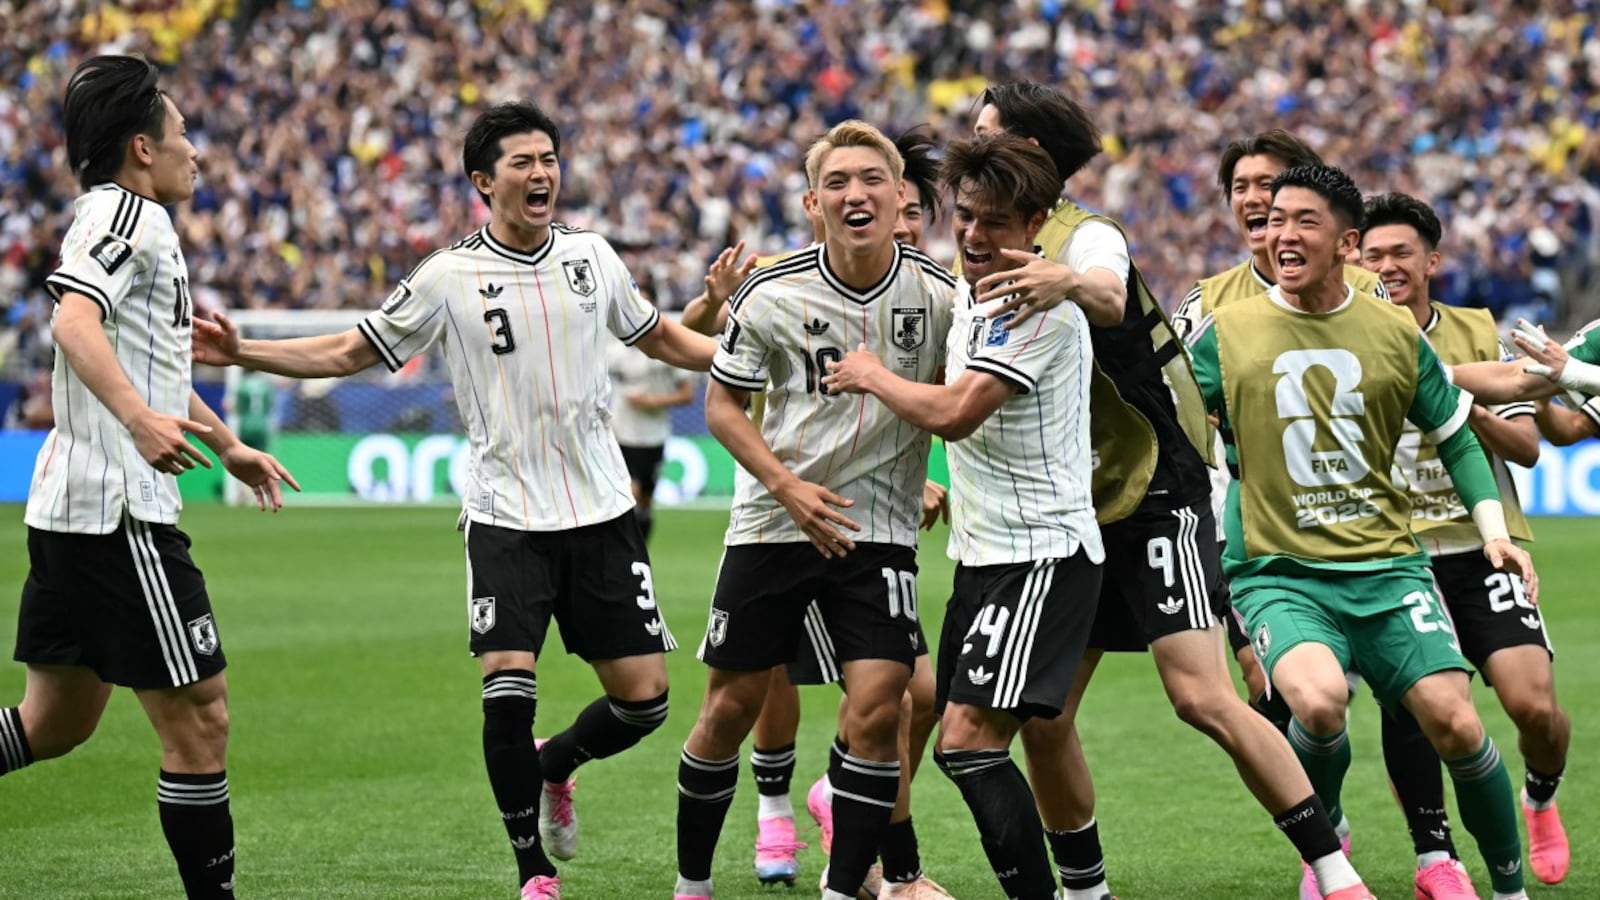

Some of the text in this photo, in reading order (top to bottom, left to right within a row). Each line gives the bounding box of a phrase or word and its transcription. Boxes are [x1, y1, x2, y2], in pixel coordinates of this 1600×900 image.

[484, 308, 514, 354] 3
[1311, 458, 1348, 474] FIFA
[1292, 490, 1346, 506] WORLD
[1295, 501, 1382, 529] 2026
[1147, 536, 1175, 587] 9
[631, 561, 656, 610] 3
[882, 567, 917, 622] 10
